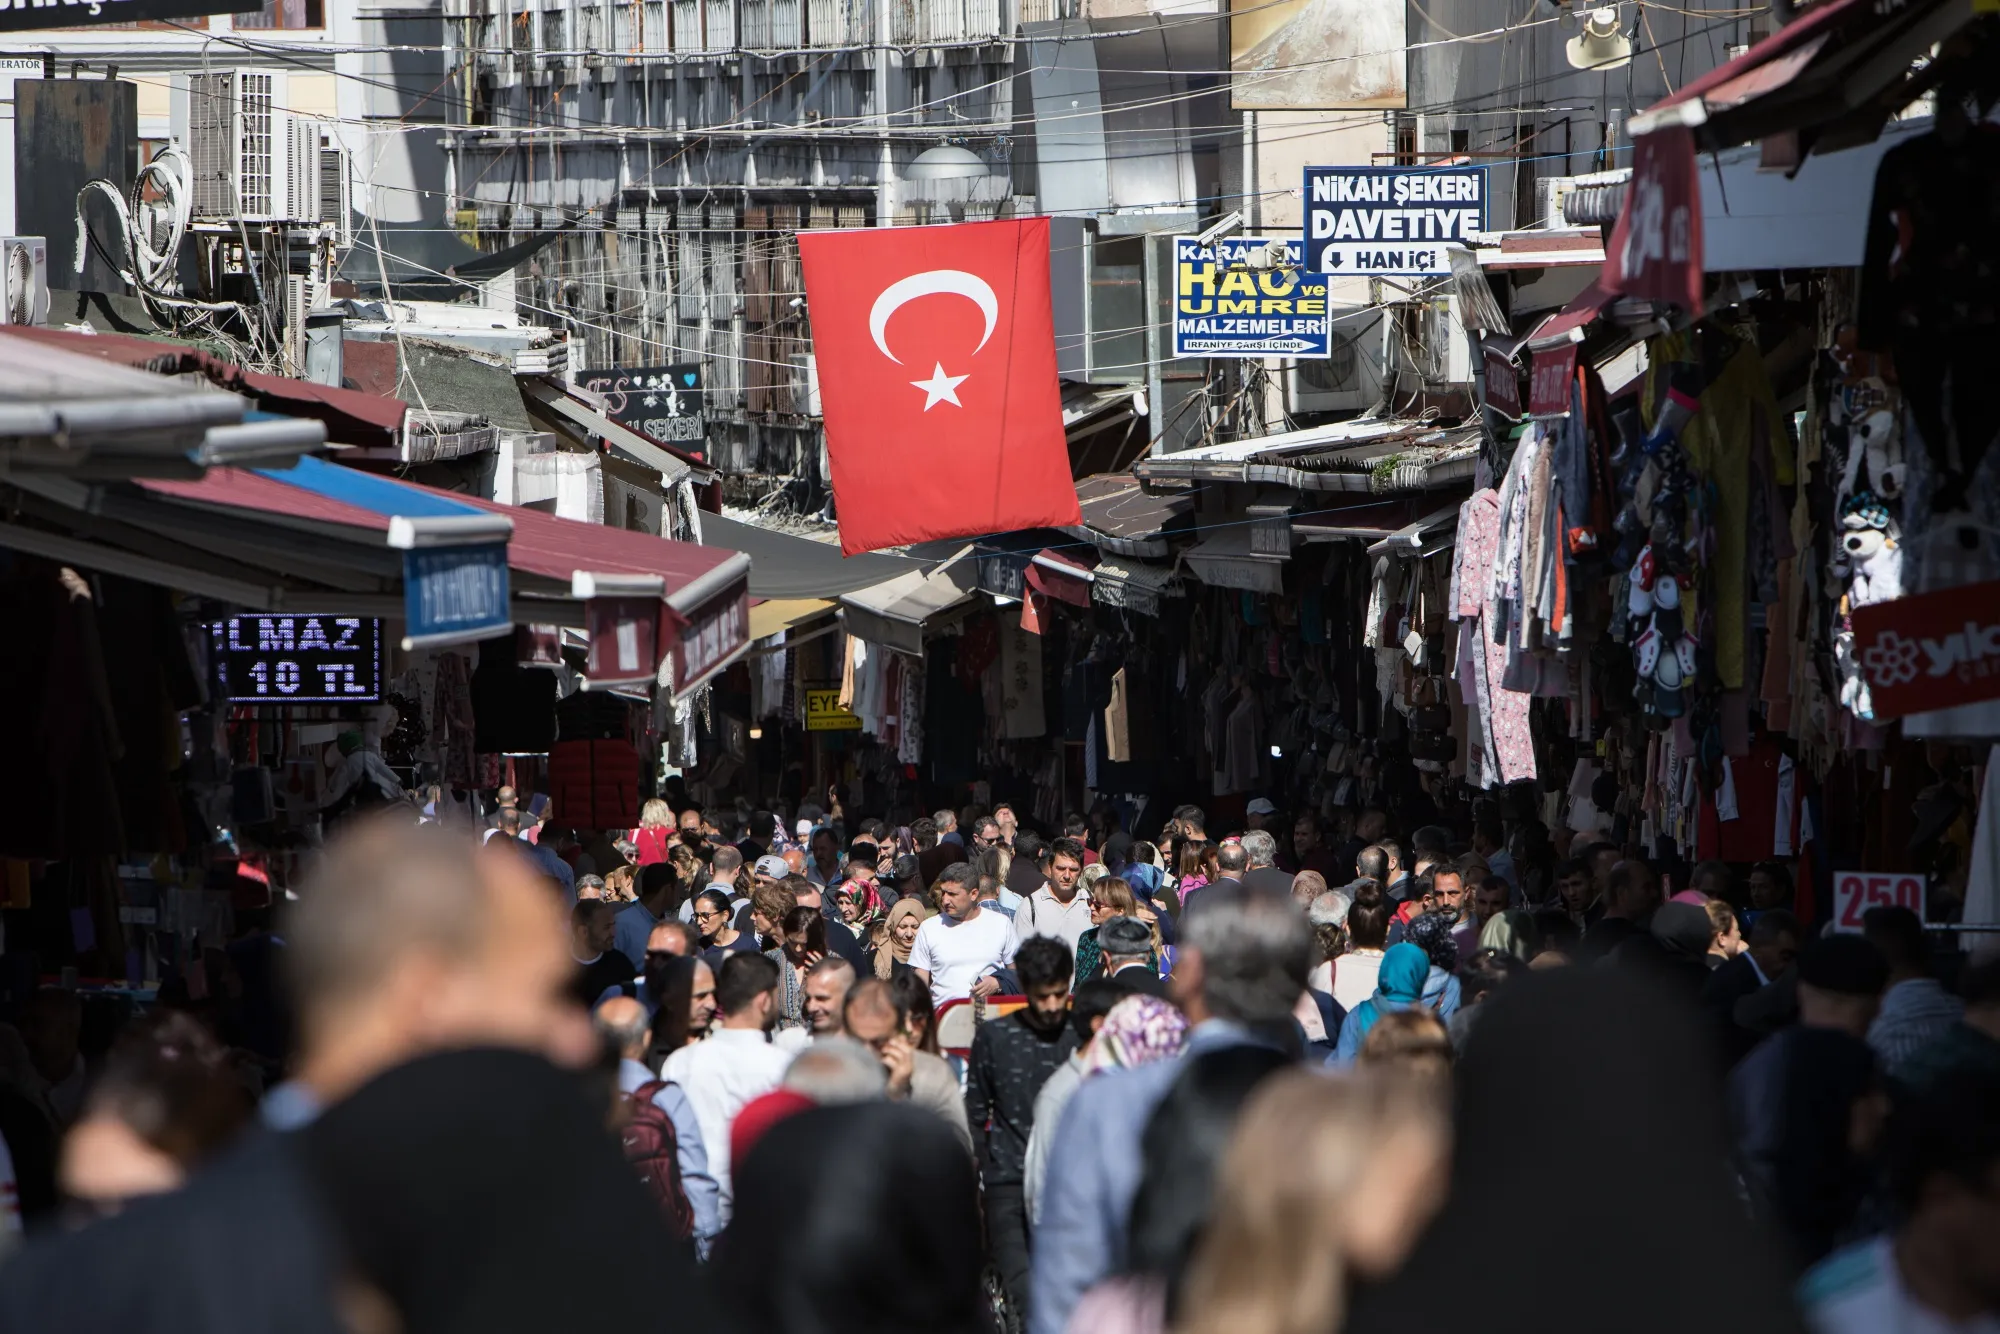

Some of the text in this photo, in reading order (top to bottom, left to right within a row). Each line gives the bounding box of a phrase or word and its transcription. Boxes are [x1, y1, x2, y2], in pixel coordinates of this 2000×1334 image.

[1312, 174, 1479, 206] NİKAH ŞEKERİ
[1312, 207, 1480, 240] DAVETİYE
[1179, 245, 1301, 260] KARAN
[1356, 250, 1436, 272] HAN İÇİ
[1300, 284, 1326, 298] ve
[1179, 299, 1326, 315] UMRE
[1178, 316, 1326, 335] MALZEMELERİ
[1269, 340, 1303, 351] İÇİNDE
[248, 660, 366, 694] 10 TL
